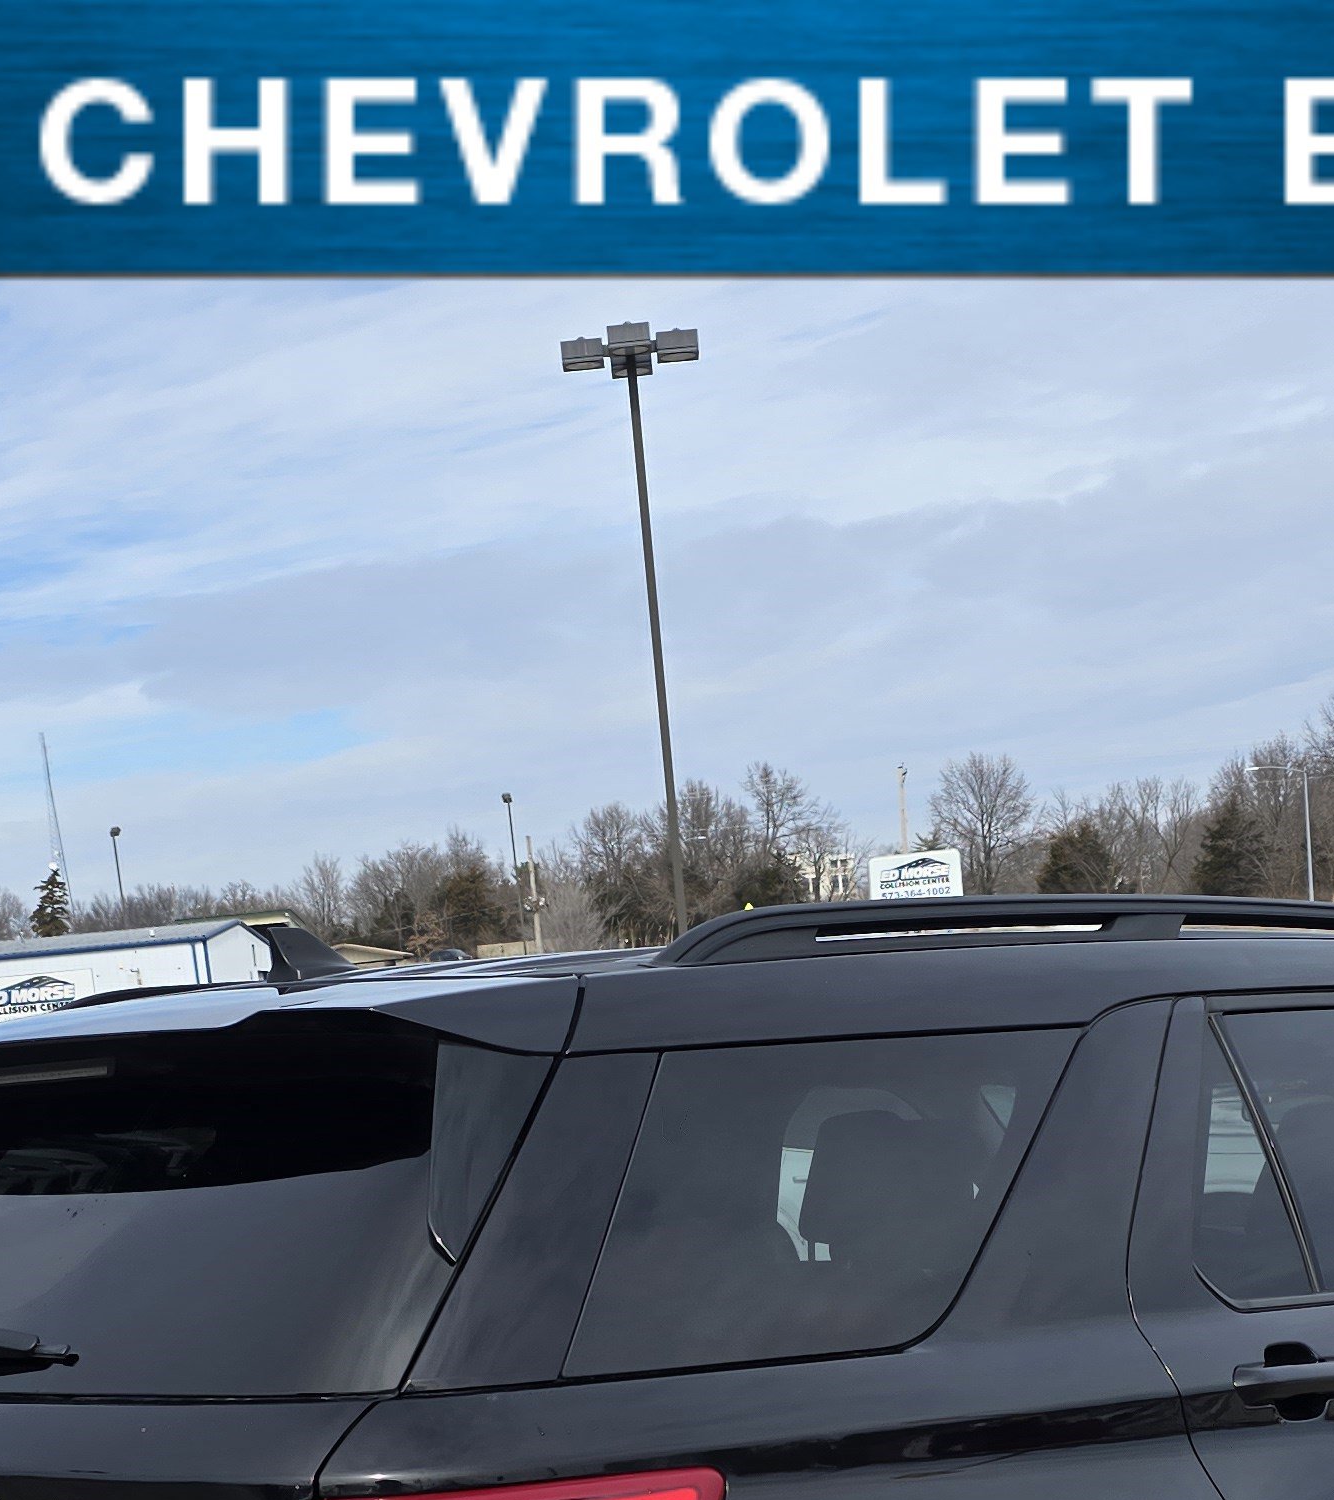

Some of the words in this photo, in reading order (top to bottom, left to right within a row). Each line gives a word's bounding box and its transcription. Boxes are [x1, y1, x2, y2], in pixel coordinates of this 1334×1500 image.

[880, 869, 900, 883] ED
[900, 864, 949, 881] MORSE
[880, 881, 920, 889] COLLISION
[922, 877, 950, 886] CENTER
[9, 984, 75, 1005] MORSE
